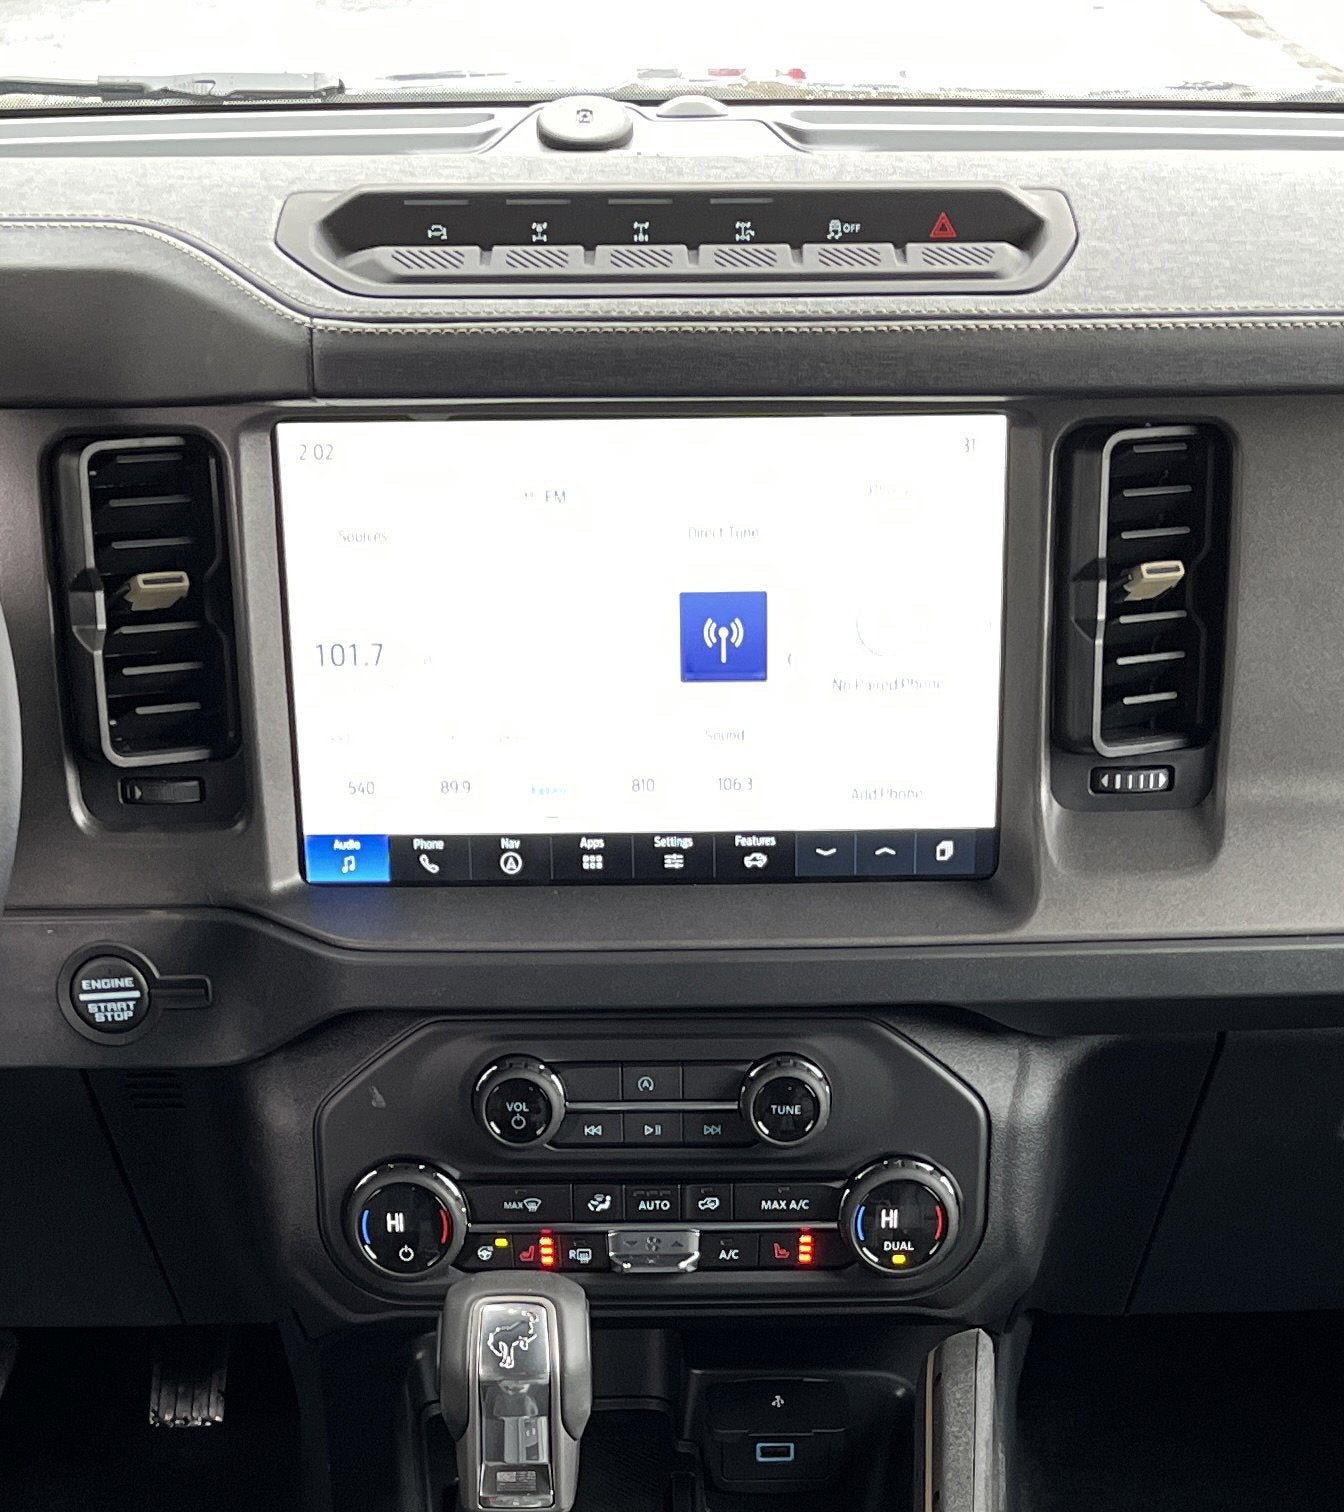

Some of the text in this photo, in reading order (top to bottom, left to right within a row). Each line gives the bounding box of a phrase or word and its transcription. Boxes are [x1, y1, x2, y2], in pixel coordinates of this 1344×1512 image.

[842, 222, 861, 234] OFF
[315, 643, 384, 667] 101.7
[348, 780, 376, 795] 540
[630, 778, 656, 793] 810
[333, 838, 361, 851] Audio
[412, 837, 444, 851] Phone
[500, 837, 521, 850] Nav
[579, 837, 605, 851] Apps
[653, 836, 693, 850] Settings
[734, 834, 776, 847] Features
[81, 976, 135, 991] ENGINE
[87, 1000, 137, 1013] START
[94, 1011, 134, 1023] STOP
[506, 1102, 529, 1113] VOL
[770, 1104, 802, 1116] TUNE
[503, 1200, 524, 1210] MAX
[638, 1200, 671, 1211] AUTO
[761, 1198, 810, 1212] MAX A/C
[386, 1212, 404, 1233] HI
[880, 1208, 899, 1229] HI
[883, 1241, 914, 1251] DUAL
[568, 1248, 577, 1259] R
[719, 1248, 740, 1261] A/C
